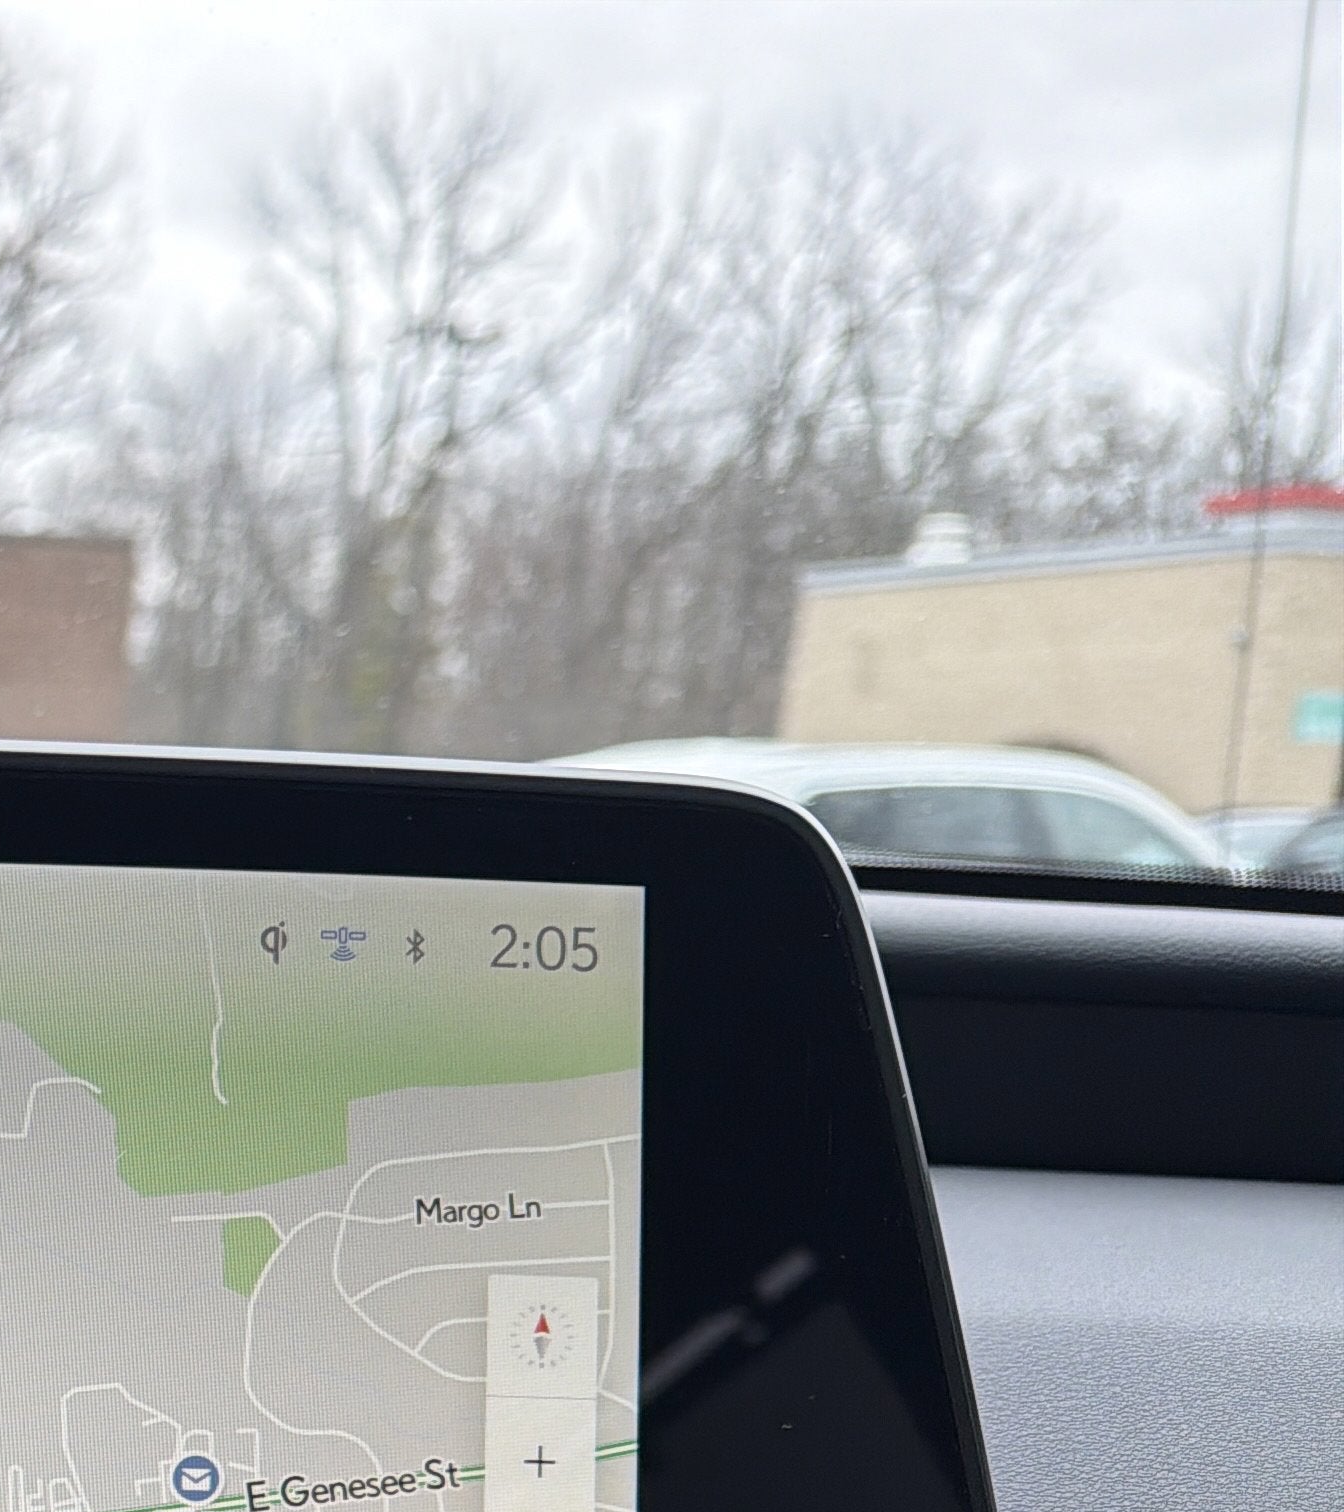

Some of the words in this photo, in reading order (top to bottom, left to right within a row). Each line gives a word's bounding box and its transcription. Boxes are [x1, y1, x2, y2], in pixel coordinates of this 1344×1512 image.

[490, 924, 598, 973] 2:05
[415, 1196, 500, 1229] Margo
[508, 1193, 542, 1220] Ln
[245, 1480, 266, 1512] E
[279, 1470, 417, 1508] Genesee
[423, 1458, 460, 1491] St
